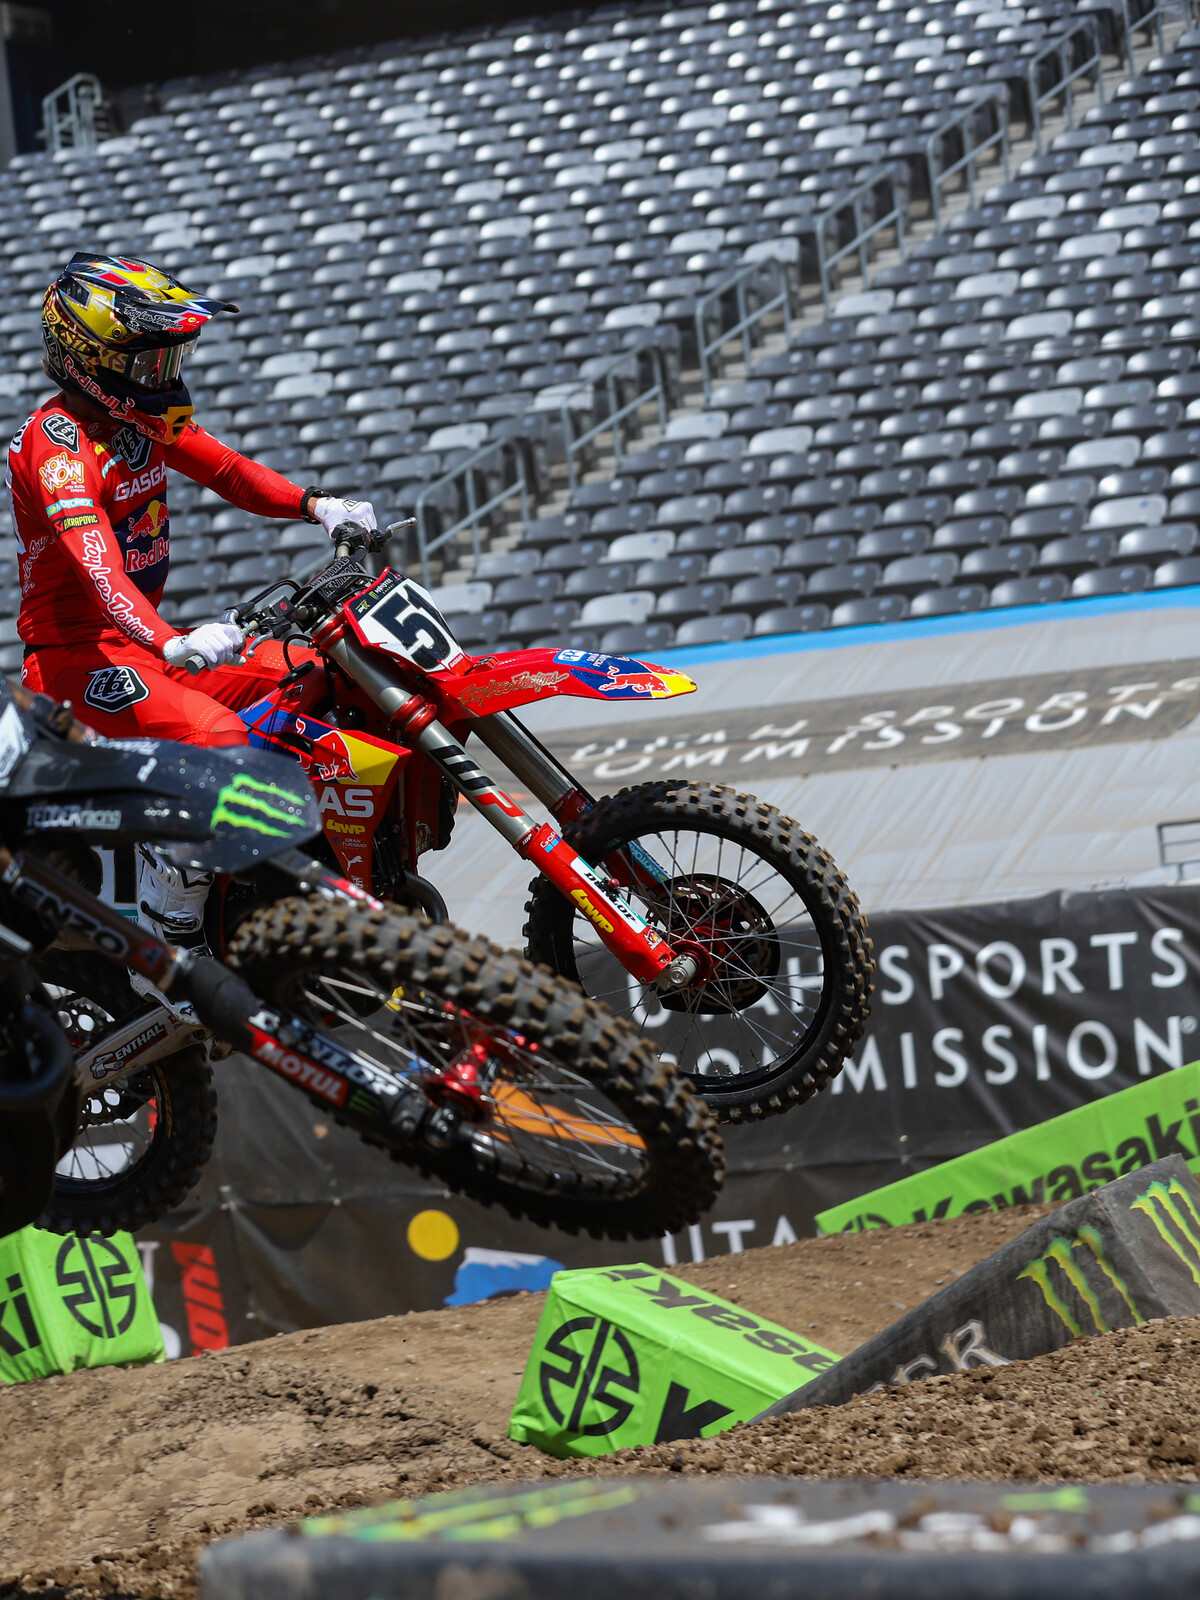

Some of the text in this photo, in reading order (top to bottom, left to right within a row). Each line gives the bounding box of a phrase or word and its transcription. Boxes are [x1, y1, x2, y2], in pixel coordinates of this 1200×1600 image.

[64, 355, 121, 410] Red Bull
[113, 460, 167, 501] GASGA
[125, 538, 158, 573] Red
[370, 584, 462, 670] 51
[879, 927, 1187, 1004] SPORTS
[91, 1023, 165, 1080] RENTHAL
[256, 1041, 343, 1099] MOTUL
